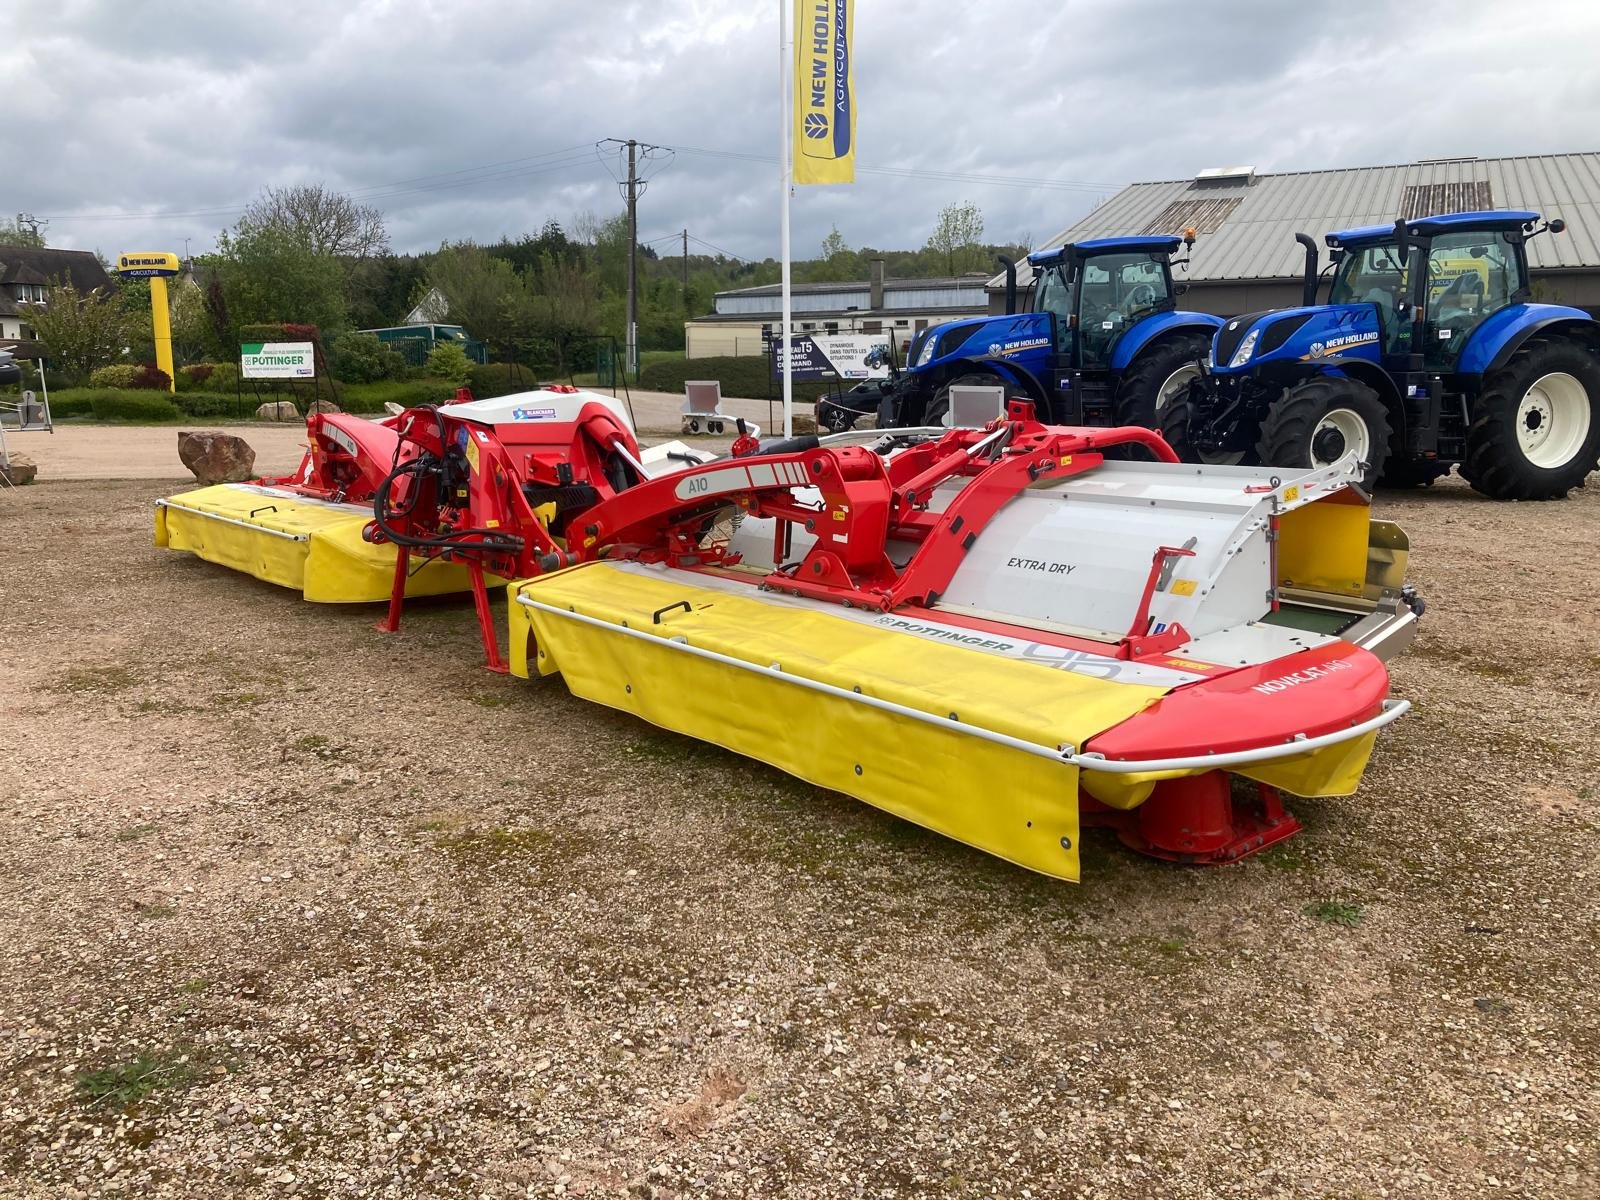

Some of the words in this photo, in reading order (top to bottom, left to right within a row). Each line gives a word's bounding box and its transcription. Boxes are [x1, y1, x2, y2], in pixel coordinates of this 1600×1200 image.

[813, 0, 829, 54] HOLL
[836, 0, 845, 112] AGRICULTURE
[811, 59, 827, 107] NEW
[800, 342, 812, 352] T5
[1005, 342, 1020, 350] NEW
[1020, 338, 1048, 346] HOLLAND
[1326, 338, 1344, 349] NEW
[1345, 331, 1378, 344] HOLLAND
[688, 477, 708, 494] A10
[1007, 557, 1047, 571] EXTRA
[1048, 563, 1077, 575] DRY
[1251, 666, 1328, 695] NOVACAT
[1322, 659, 1353, 673] A10
